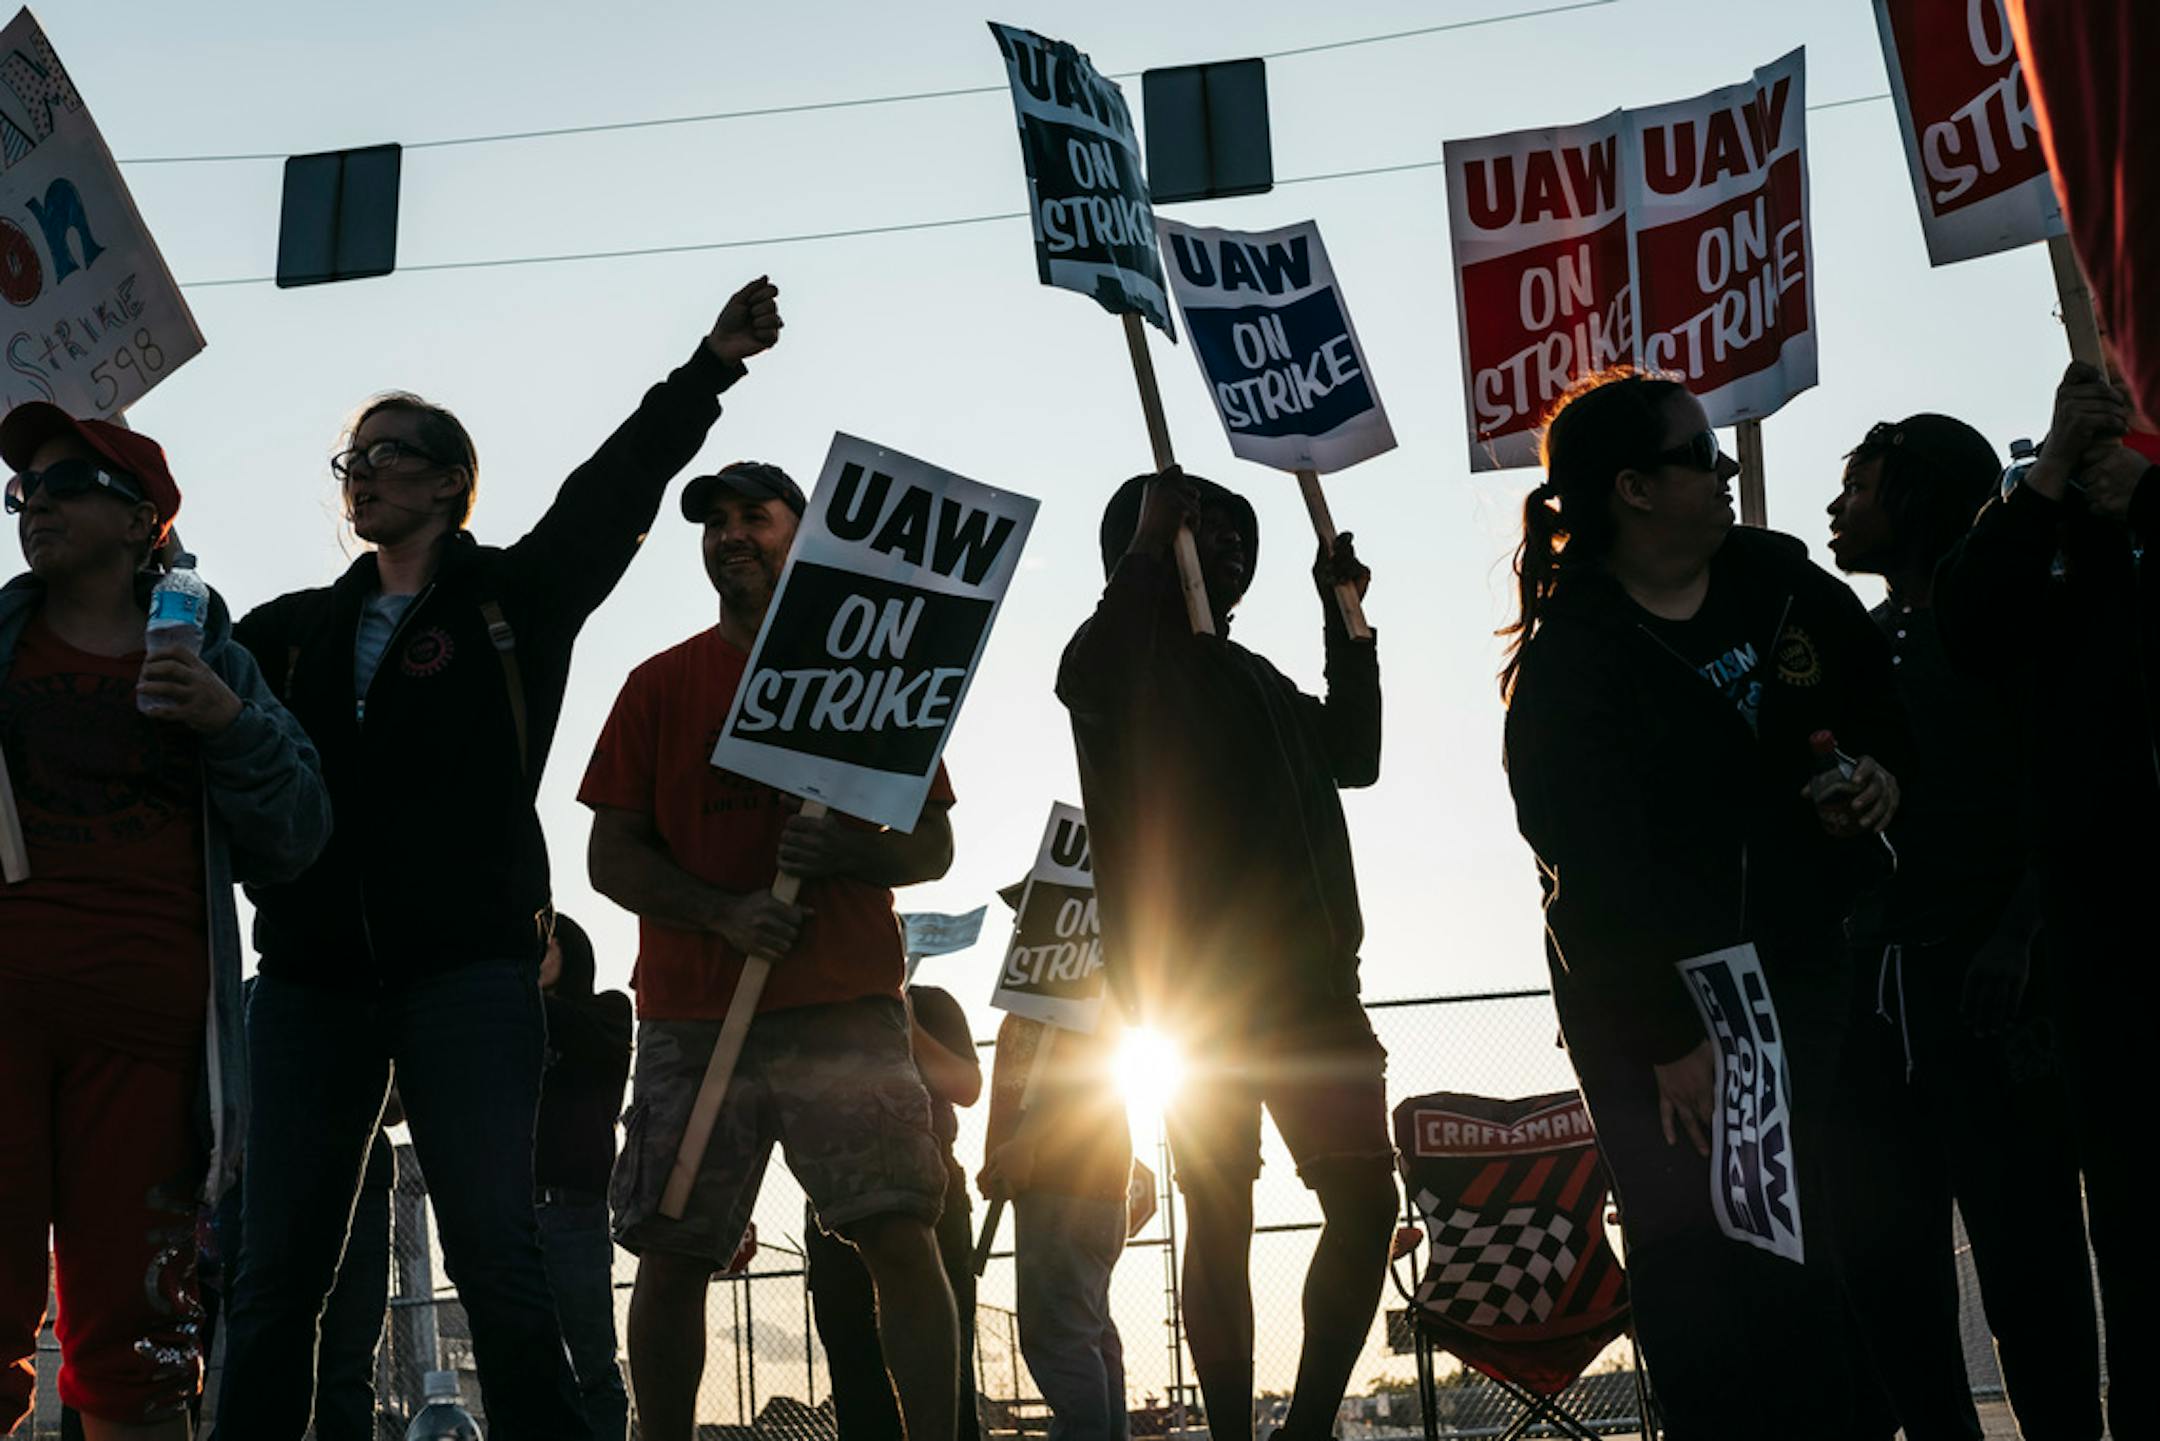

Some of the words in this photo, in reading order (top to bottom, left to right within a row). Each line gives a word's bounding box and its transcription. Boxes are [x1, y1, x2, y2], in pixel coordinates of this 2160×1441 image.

[1066, 137, 1120, 190] ON
[1464, 134, 1617, 229] UAW
[1170, 233, 1312, 295] UAW
[1519, 243, 1595, 333] ON
[1697, 195, 1768, 294] ON
[90, 327, 163, 411] 598
[1216, 333, 1360, 428] STRIKE
[1233, 313, 1292, 369] ON
[1474, 284, 1632, 434] STRIKE
[826, 462, 1015, 586] UAW
[826, 594, 925, 661] ON
[737, 667, 967, 733] STRIKE
[1427, 1109, 1589, 1147] CRAFTSMAN
[1737, 1034, 1758, 1144] ON
